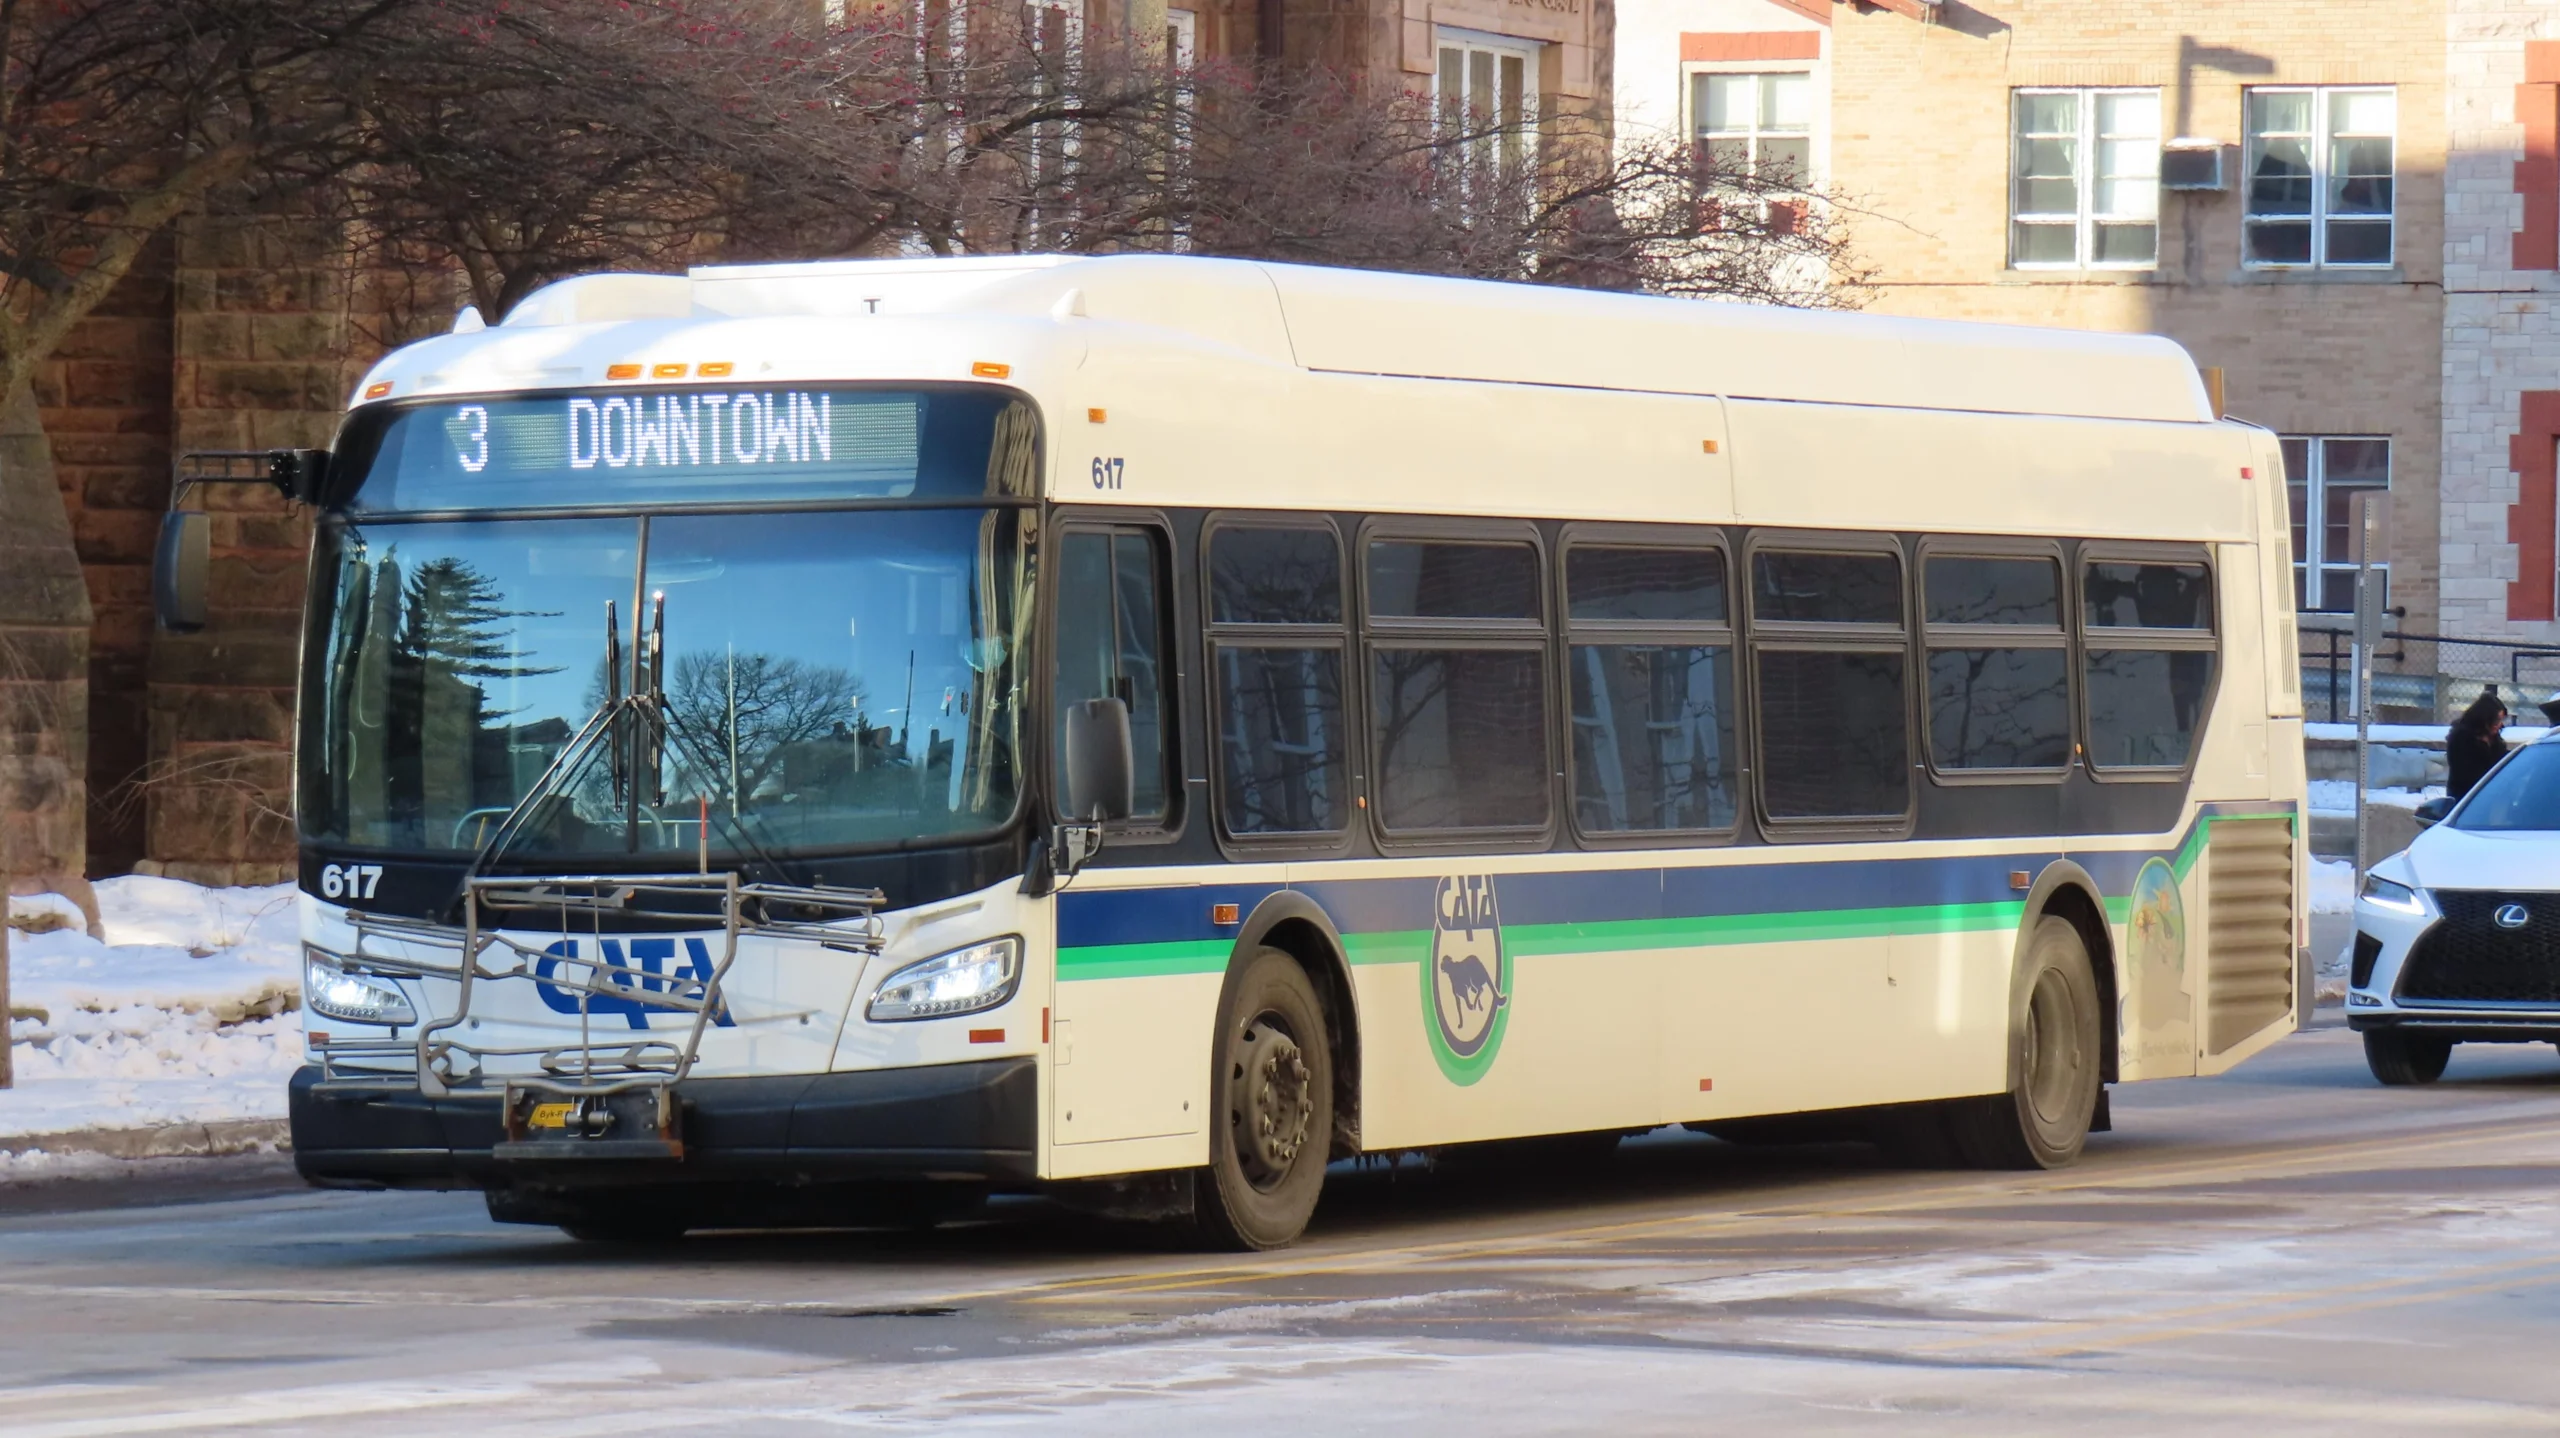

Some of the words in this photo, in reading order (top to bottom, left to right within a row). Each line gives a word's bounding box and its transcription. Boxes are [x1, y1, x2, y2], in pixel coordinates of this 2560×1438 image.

[457, 405, 488, 472] 3
[568, 392, 831, 469] DOWNTOWN
[1092, 456, 1124, 490] 617
[322, 863, 383, 899] 617
[1436, 874, 1500, 942] CATA
[535, 938, 738, 1030] CATA
[540, 1110, 564, 1119] Byk-R
